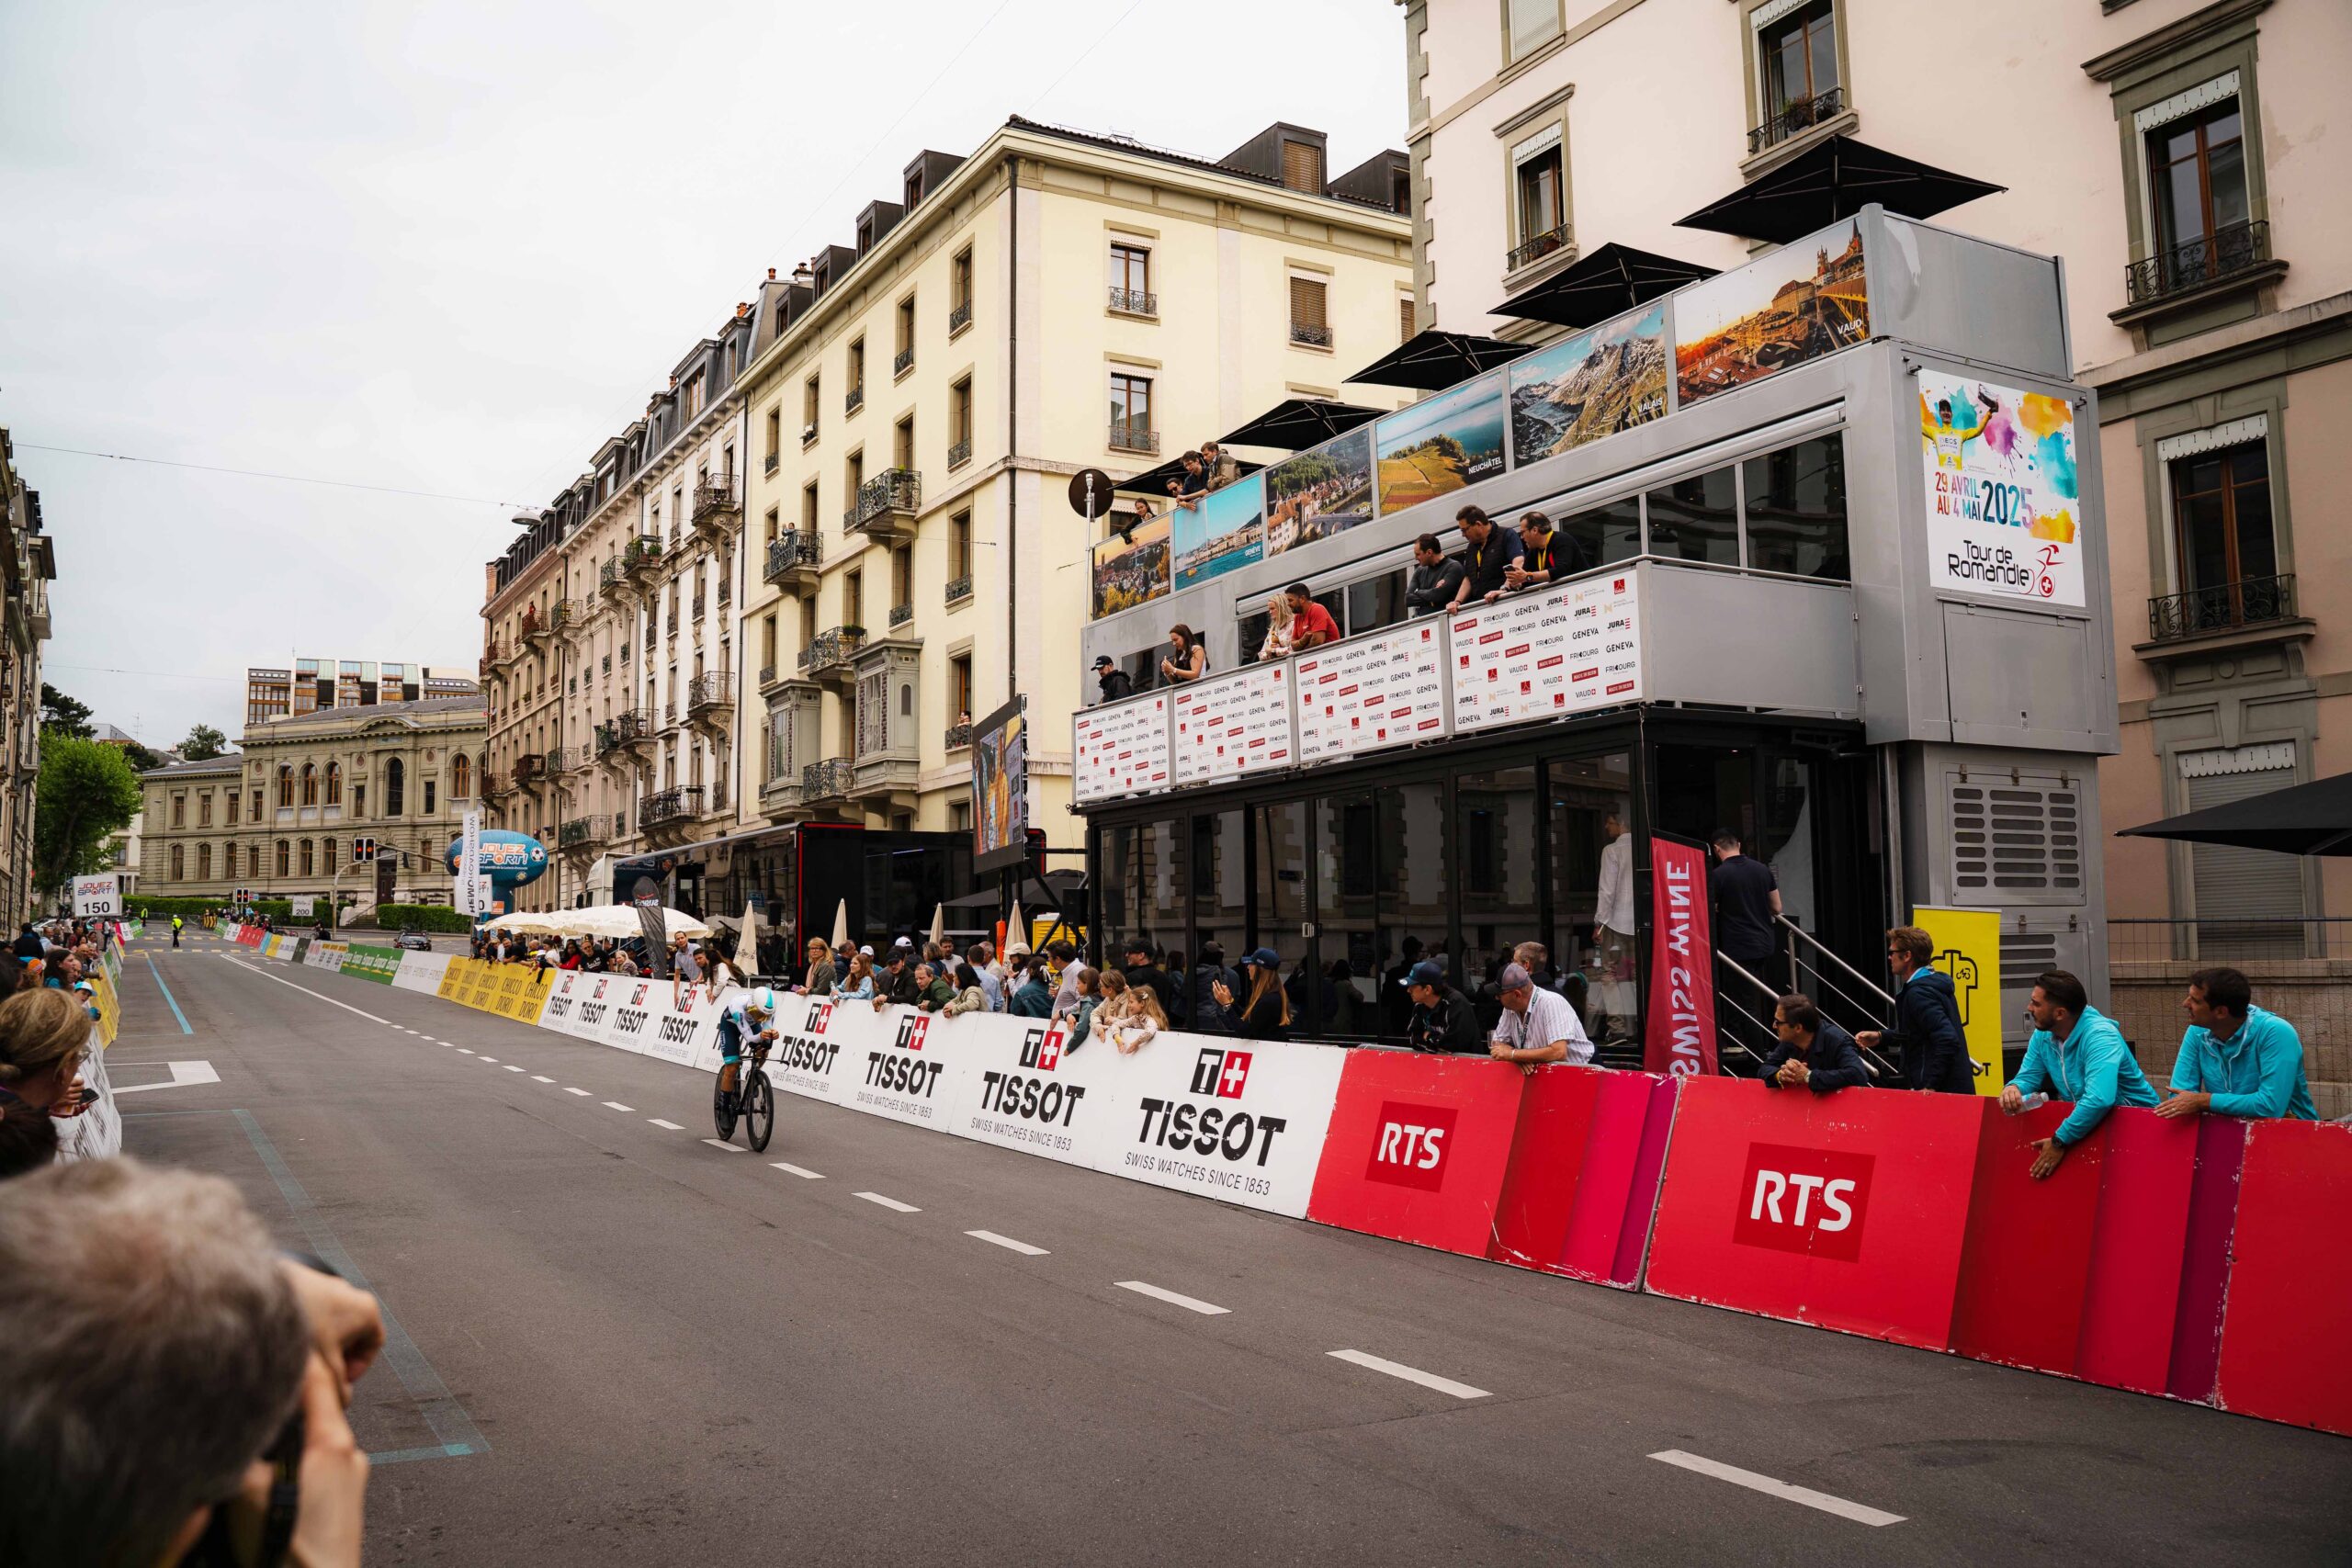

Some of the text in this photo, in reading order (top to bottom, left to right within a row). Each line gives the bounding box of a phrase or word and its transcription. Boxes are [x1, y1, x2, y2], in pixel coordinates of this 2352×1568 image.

[1838, 319, 1862, 334] VAUD
[1637, 398, 1663, 413] VALAIS
[1468, 457, 1503, 475] NEUCHÂTEL
[1935, 472, 1980, 498] 29 AVRIL
[1937, 494, 1980, 521] AU 4 MAI
[1981, 480, 2034, 530] 2025
[1963, 540, 2013, 564] Tour de
[1948, 553, 2029, 587] Romandie
[1515, 604, 1540, 616] GENEVA
[1547, 596, 1563, 606] JURA
[1541, 615, 1566, 627] GENEVA
[1574, 607, 1590, 617] JURA
[1573, 628, 1599, 639] GENEVA
[1607, 620, 1624, 629] JURA
[1346, 650, 1365, 660] GENEVA
[1606, 641, 1634, 653] GENEVA
[1366, 660, 1386, 670] GENEVA
[1417, 665, 1430, 673] JURA
[1390, 671, 1411, 682] GENEVA
[1417, 683, 1438, 694] GENEVA
[1459, 696, 1473, 704] JURA
[1458, 714, 1481, 724] GENEVA
[1490, 707, 1504, 716] JURA
[1303, 746, 1321, 755] GENEVA
[83, 902, 110, 914] 150
[478, 974, 498, 990] CHICCO
[502, 977, 522, 995] CHICCO
[525, 981, 548, 1000] CHICCO
[548, 996, 572, 1018] TISSOT
[578, 1002, 607, 1025] TISSOT
[613, 1008, 649, 1034] TISSOT
[658, 1015, 699, 1045] TISSOT
[780, 1035, 840, 1075] TISSOT
[865, 1052, 943, 1098] TISSOT
[857, 1091, 932, 1118] SWISS WATCHES SINCE 1853
[982, 1071, 1085, 1127] TISSOT
[970, 1117, 1072, 1151] SWISS WATCHES SINCE 1853
[1139, 1098, 1287, 1167] TISSOT
[1378, 1122, 1445, 1169] RTS
[1125, 1152, 1270, 1196] SWISS WATCHES SINCE 1853
[1751, 1169, 1855, 1232] RTS
